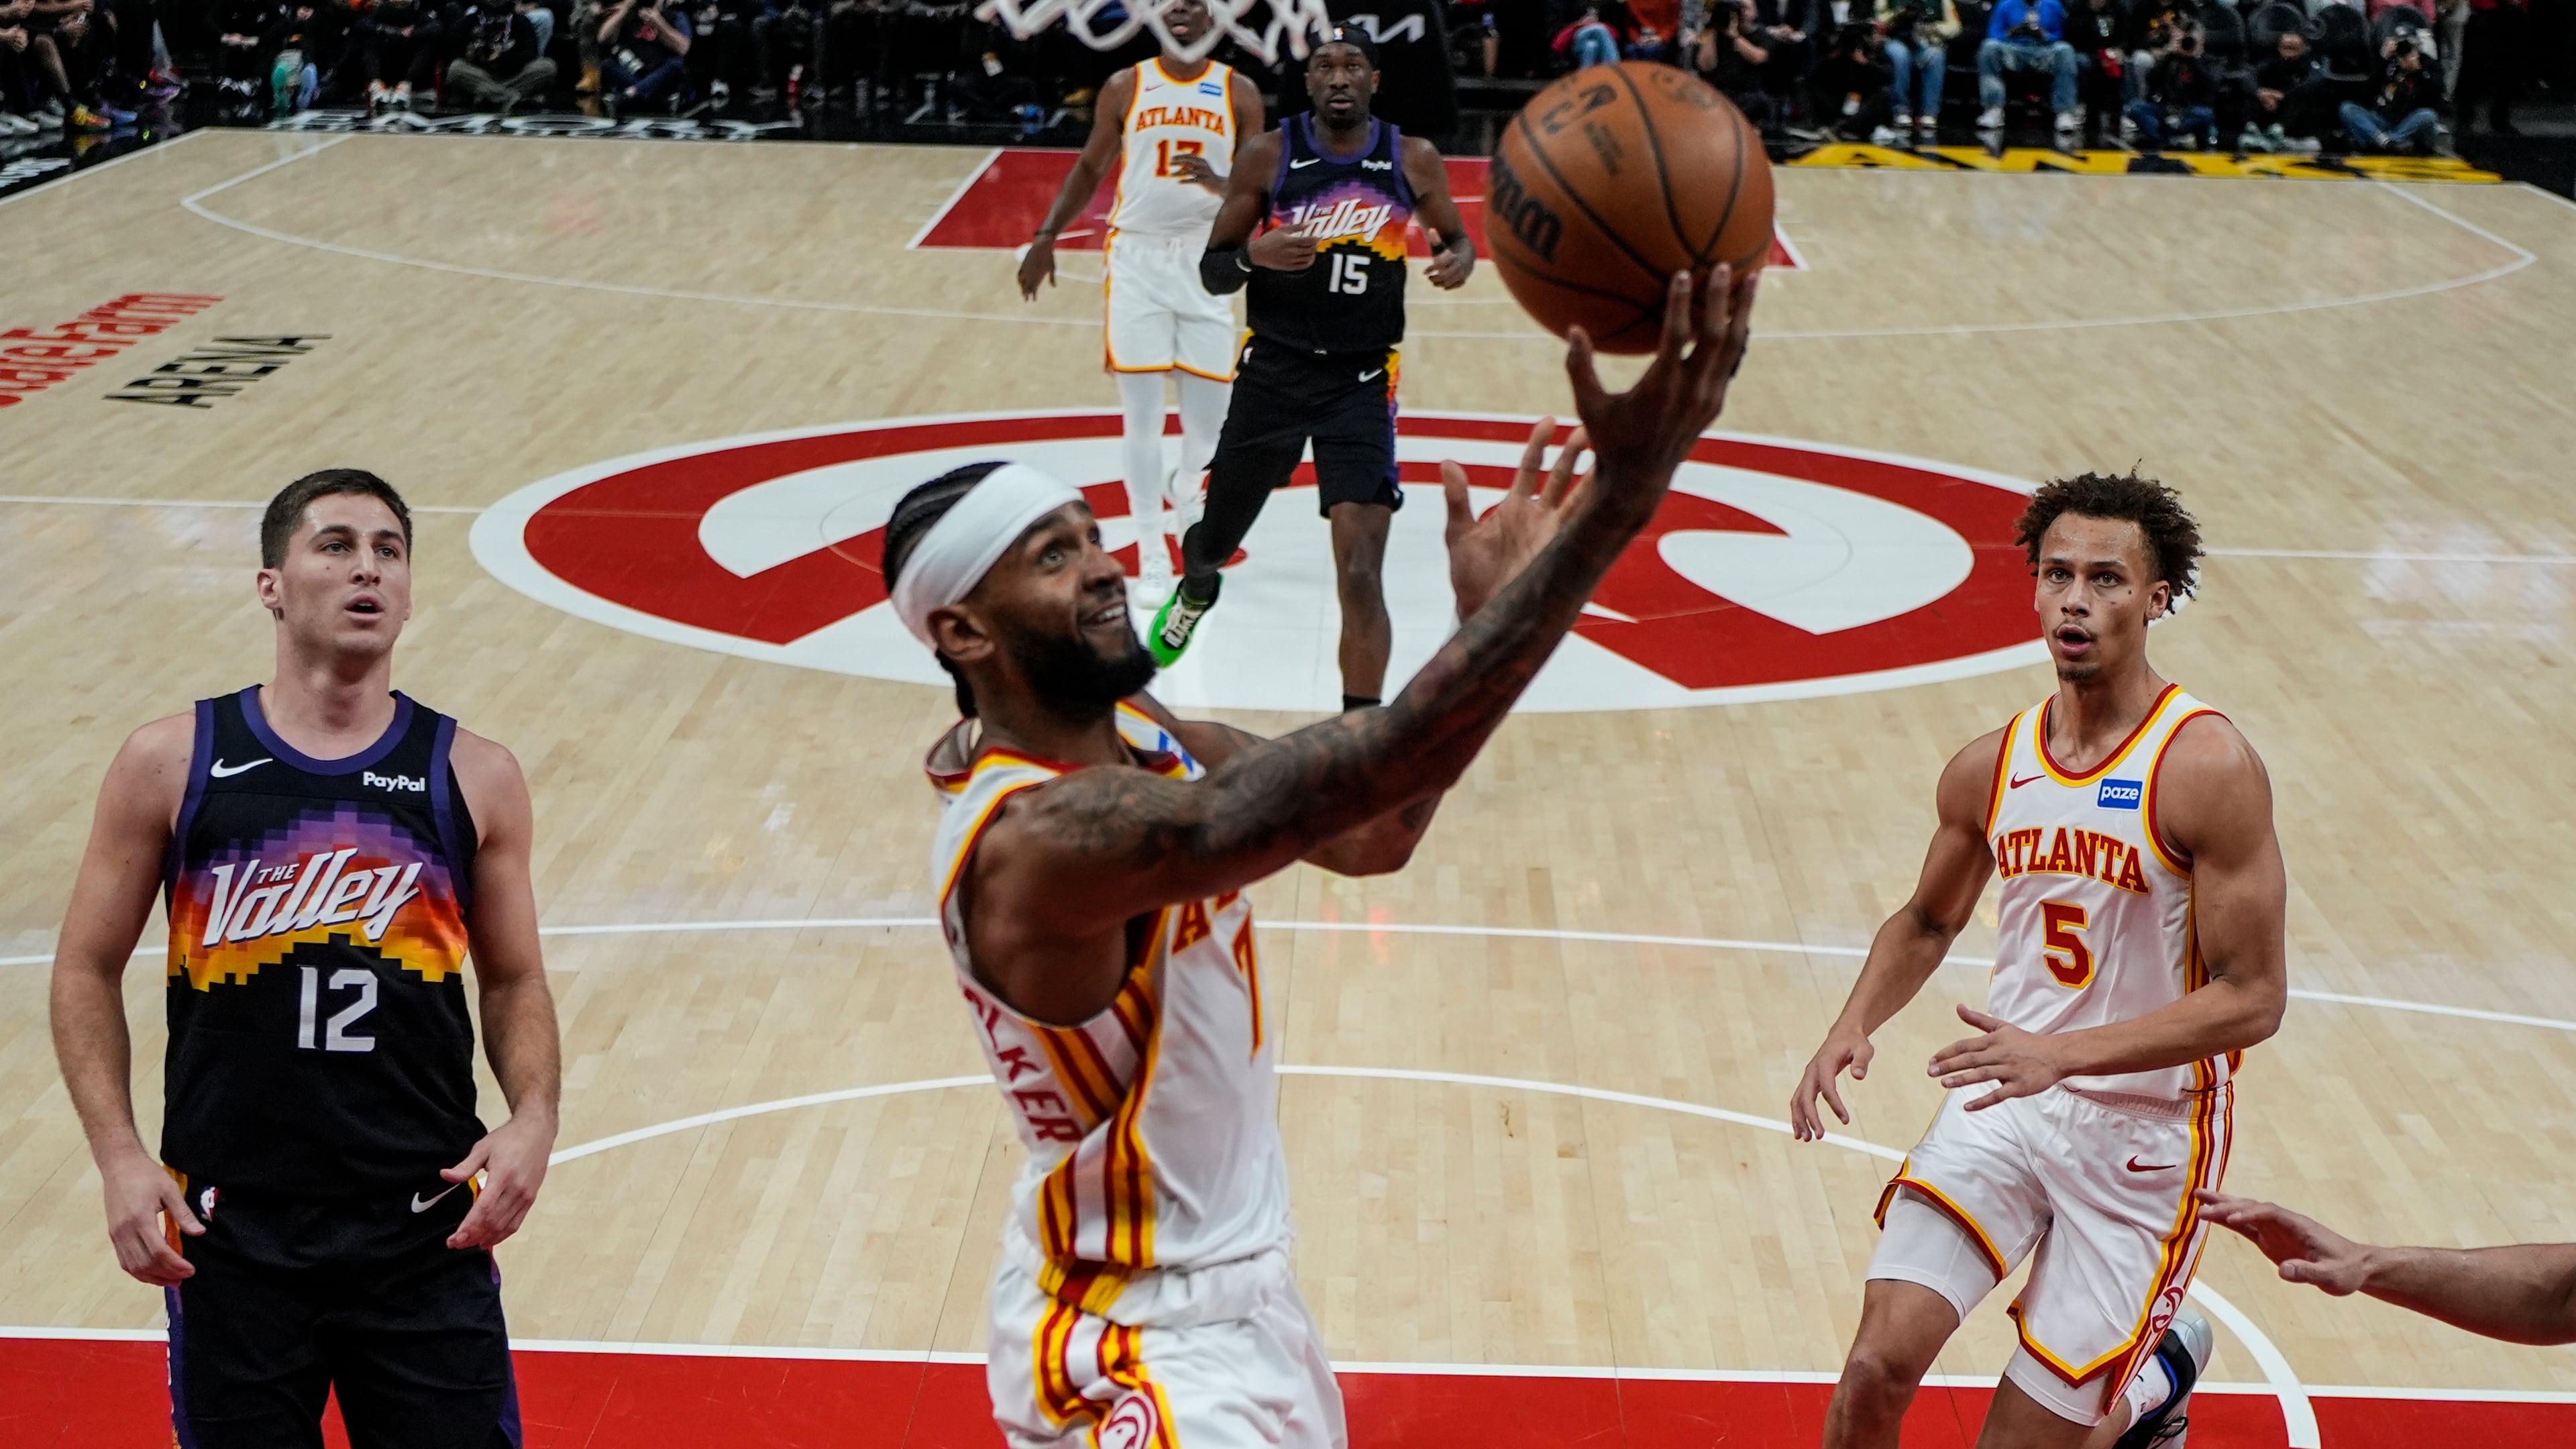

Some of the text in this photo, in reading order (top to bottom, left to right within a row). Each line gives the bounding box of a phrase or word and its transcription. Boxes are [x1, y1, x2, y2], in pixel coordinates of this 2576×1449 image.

[1136, 107, 1226, 137] ATLANTA
[1361, 159, 1393, 171] PayPal
[1329, 253, 1371, 294] 15
[102, 333, 333, 410] ARENA
[363, 771, 425, 792] PayPal
[2100, 786, 2139, 801] paze
[258, 863, 300, 882] THE
[1996, 827, 2150, 896] ATLANTA
[203, 848, 425, 948] Valley
[2041, 900, 2095, 990] 5
[297, 964, 379, 1052] 12
